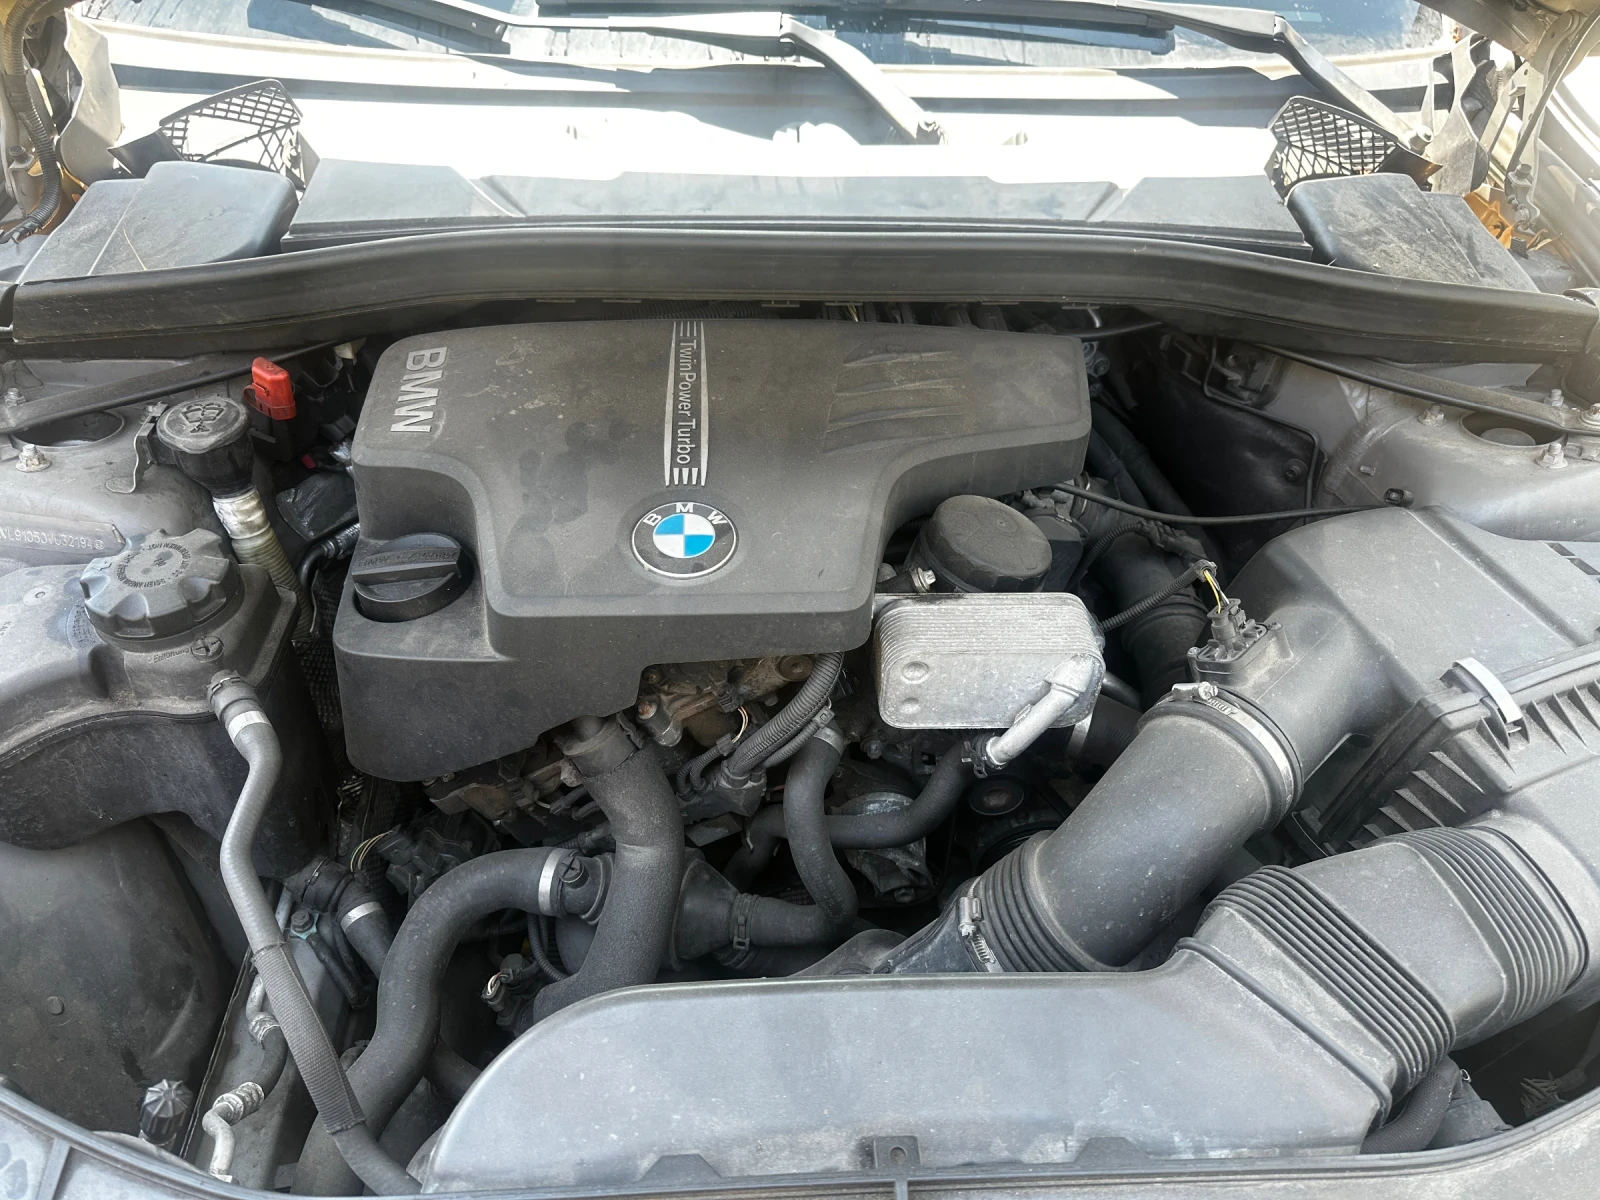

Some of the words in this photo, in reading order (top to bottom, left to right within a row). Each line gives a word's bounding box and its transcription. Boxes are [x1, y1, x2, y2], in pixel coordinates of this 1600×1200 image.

[390, 346, 448, 433] BMW
[678, 340, 698, 417] TwinPower
[677, 418, 697, 464] Turbo
